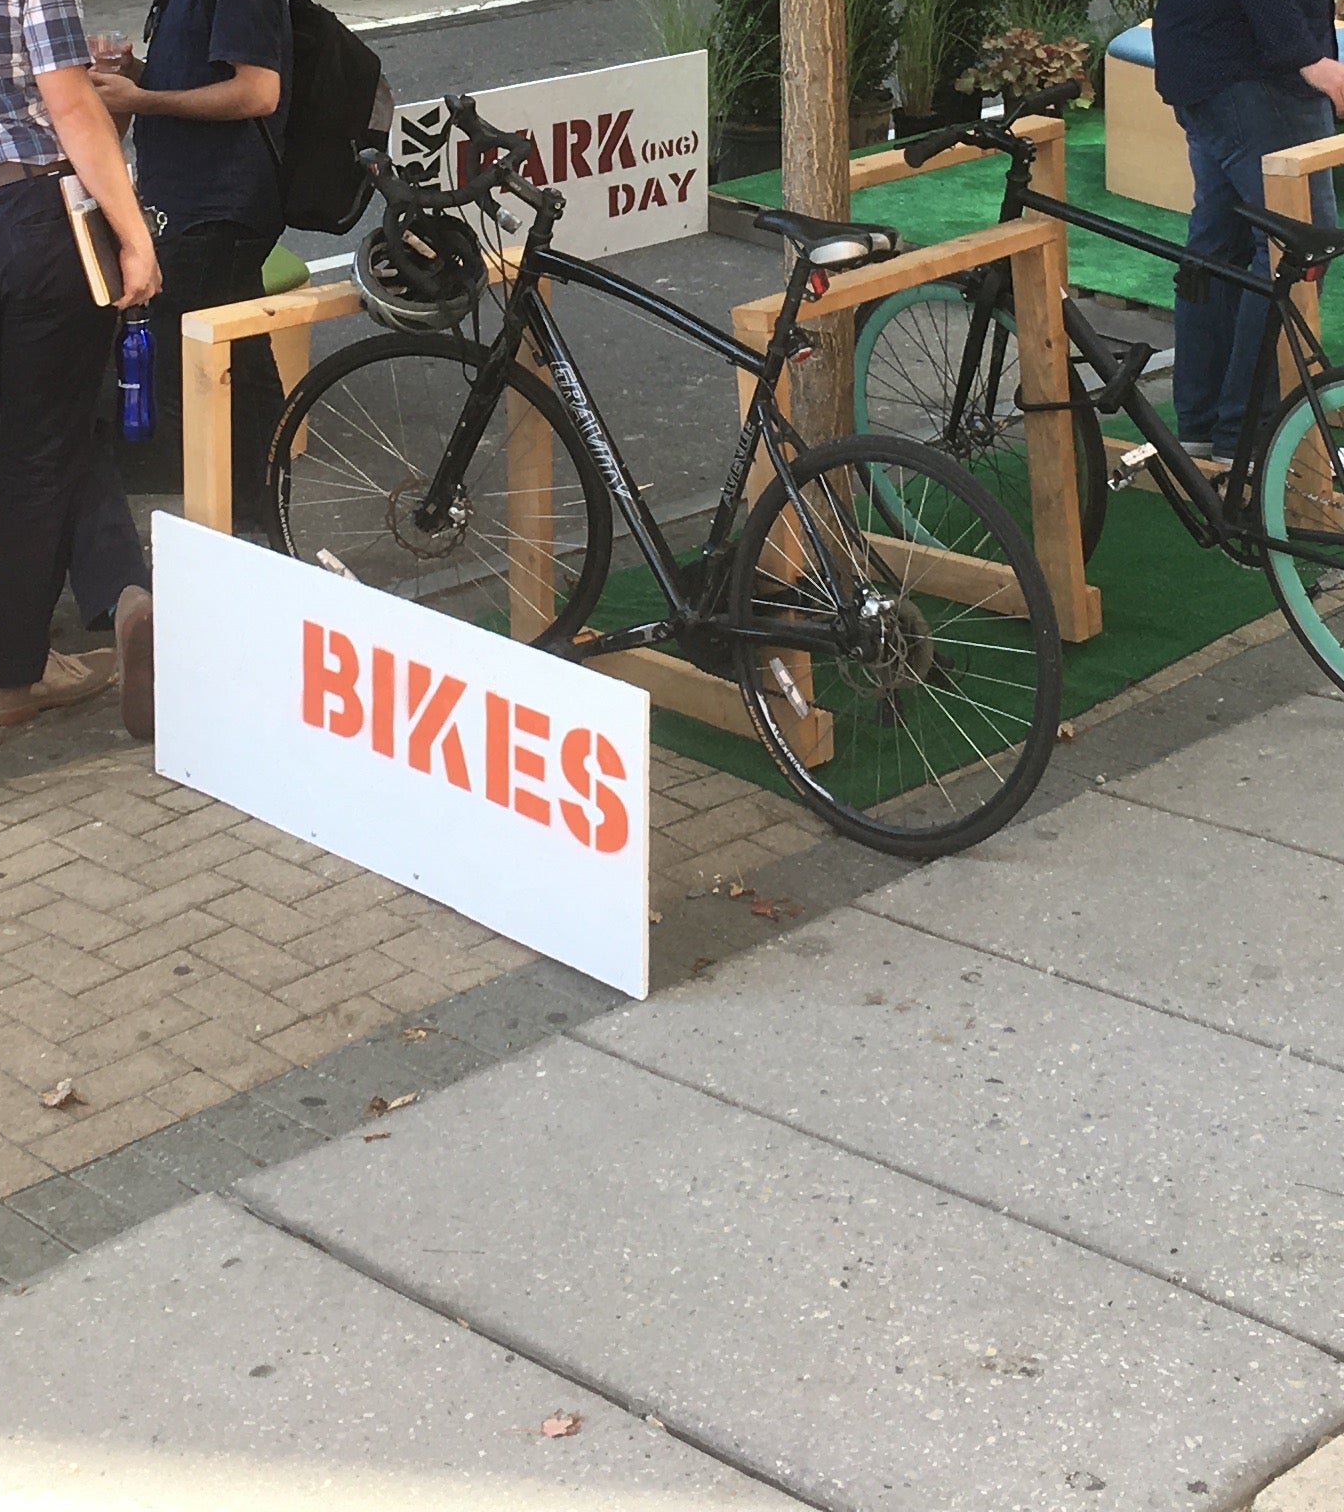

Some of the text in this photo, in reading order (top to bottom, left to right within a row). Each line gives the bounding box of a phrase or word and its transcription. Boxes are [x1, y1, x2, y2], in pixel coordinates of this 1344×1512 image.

[607, 168, 698, 218] DAY
[549, 360, 633, 500] GRAVITY
[300, 618, 630, 855] BIKES
